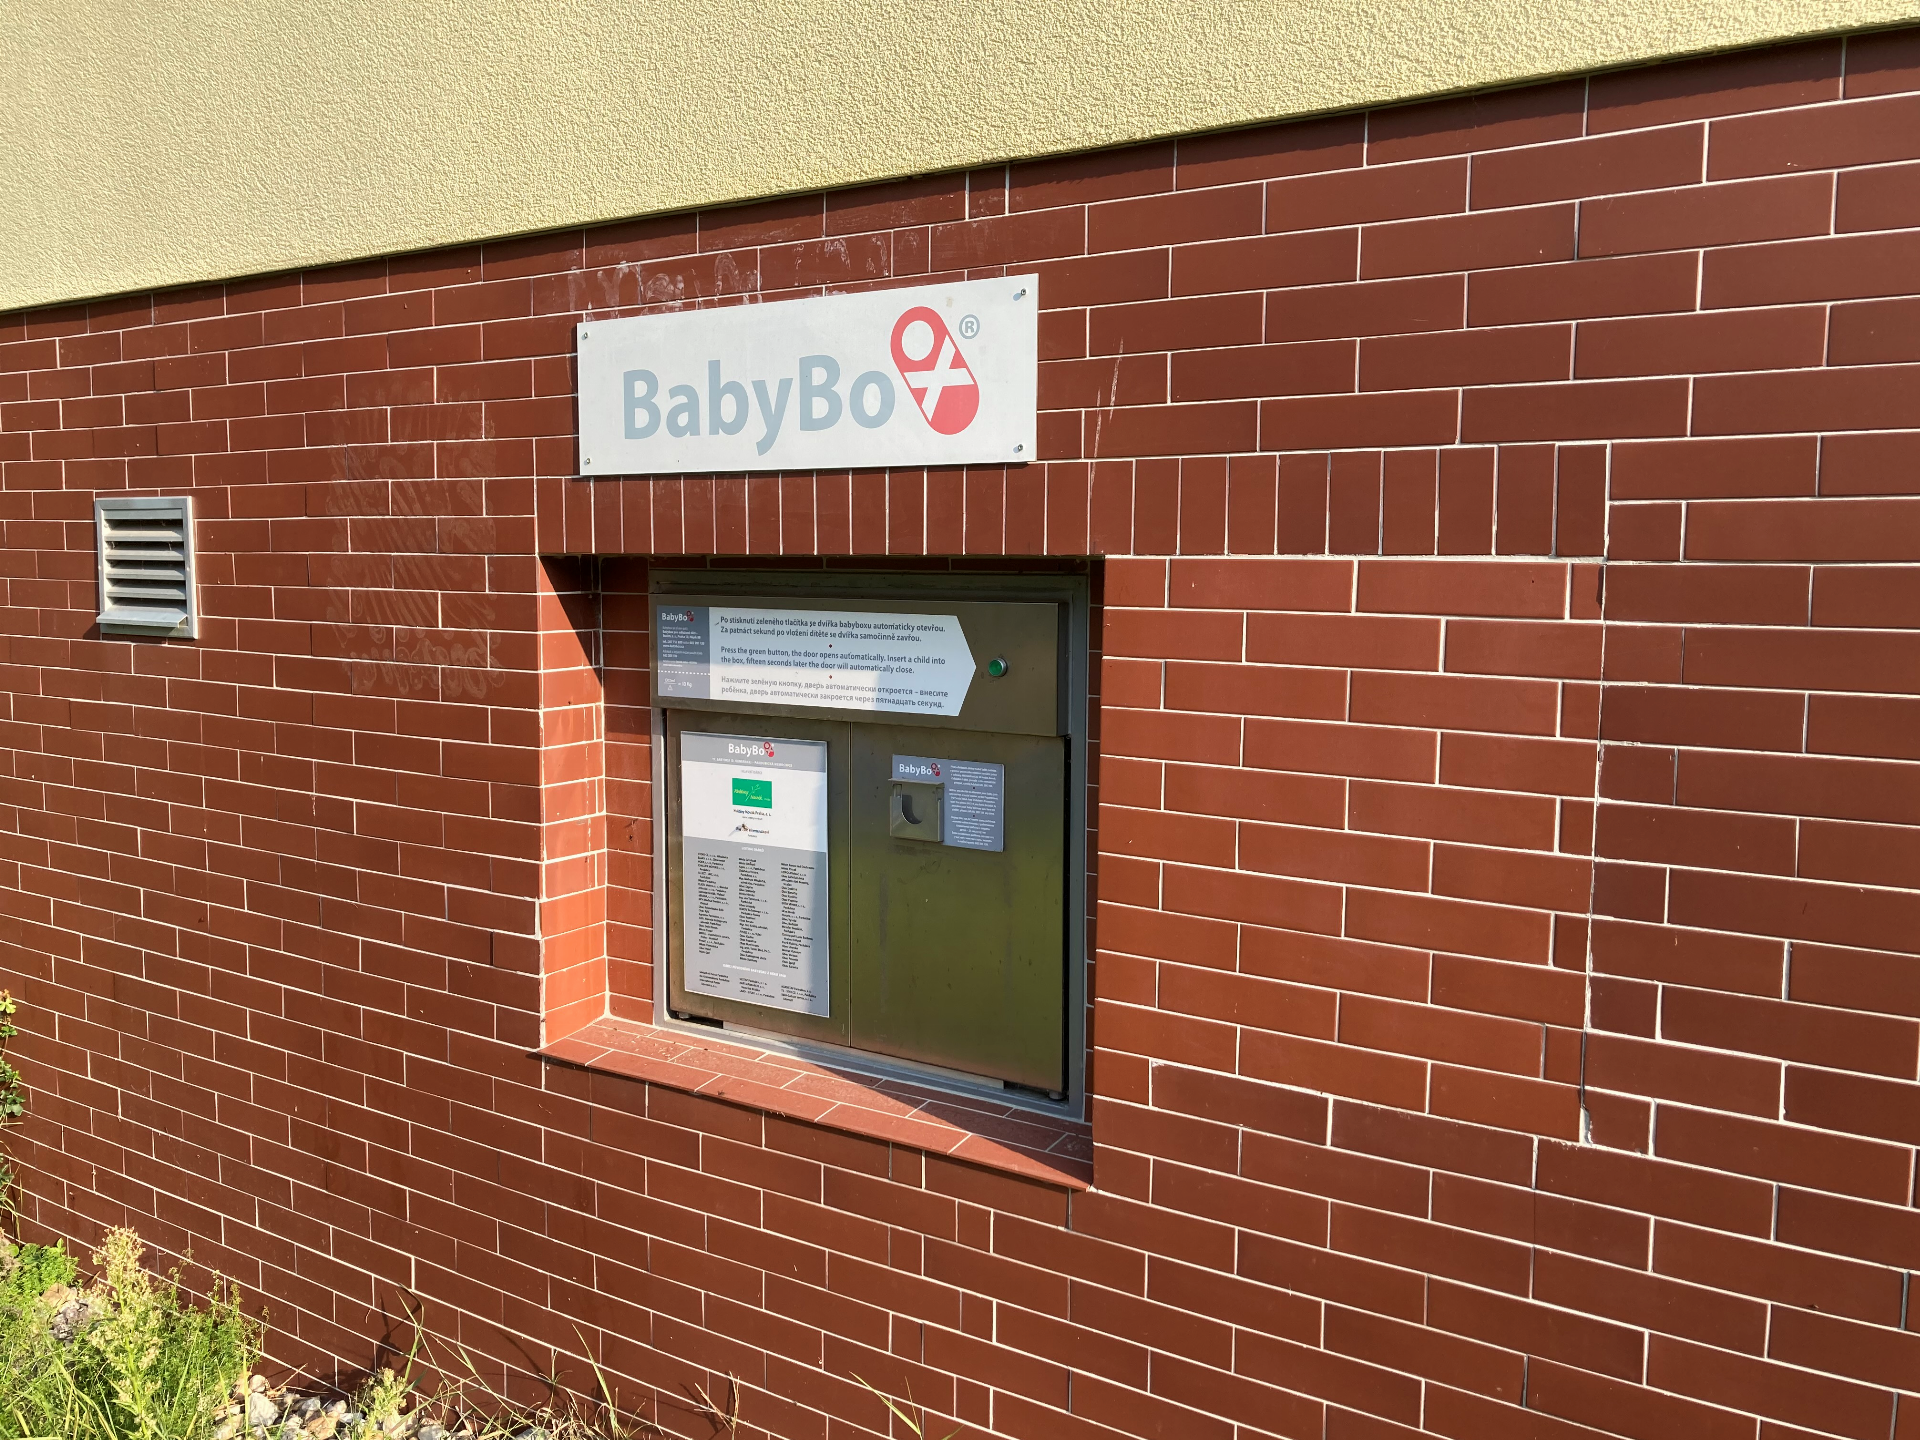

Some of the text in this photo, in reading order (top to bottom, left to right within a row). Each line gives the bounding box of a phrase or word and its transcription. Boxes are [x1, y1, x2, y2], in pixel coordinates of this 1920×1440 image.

[729, 616, 755, 625] stisknutí
[756, 617, 784, 626] zeleného
[785, 618, 808, 627] tlačítka
[817, 620, 838, 628] dvířka
[839, 621, 872, 630] babyboxu
[873, 622, 915, 632] automaticky
[916, 624, 946, 632] otevřou.
[729, 627, 752, 637] patnáct
[753, 628, 775, 636] sekund
[837, 631, 858, 639] dvířka
[859, 633, 896, 641] samočinně
[896, 634, 922, 642] zavřou.
[721, 646, 736, 654] Press
[748, 648, 766, 656] green
[767, 647, 790, 657] button,
[791, 649, 802, 657] the
[803, 649, 818, 658] door
[819, 652, 839, 660] opens
[840, 652, 886, 663] automatically.
[887, 654, 907, 663] Insert
[913, 656, 930, 664] child
[931, 656, 946, 665] into
[732, 656, 745, 665] box,
[746, 657, 767, 665] fifteen
[767, 659, 792, 667] seconds
[792, 659, 807, 668] later
[808, 660, 819, 668] the
[820, 661, 836, 669] door
[849, 663, 894, 674] automatically
[895, 665, 915, 674] close.
[721, 676, 750, 685] Нажмите
[750, 678, 778, 687] зелёную
[778, 680, 803, 689] кнопку,
[804, 682, 825, 690] дверь
[825, 683, 876, 693] автоматически
[877, 687, 913, 695] откроется
[919, 689, 949, 698] внесите
[721, 686, 748, 695] ребёнка,
[749, 688, 769, 696] дверь
[769, 690, 818, 699] автоматически
[820, 693, 854, 701] закроется
[875, 697, 916, 706] пятнадцать
[917, 700, 944, 708] секунд.
